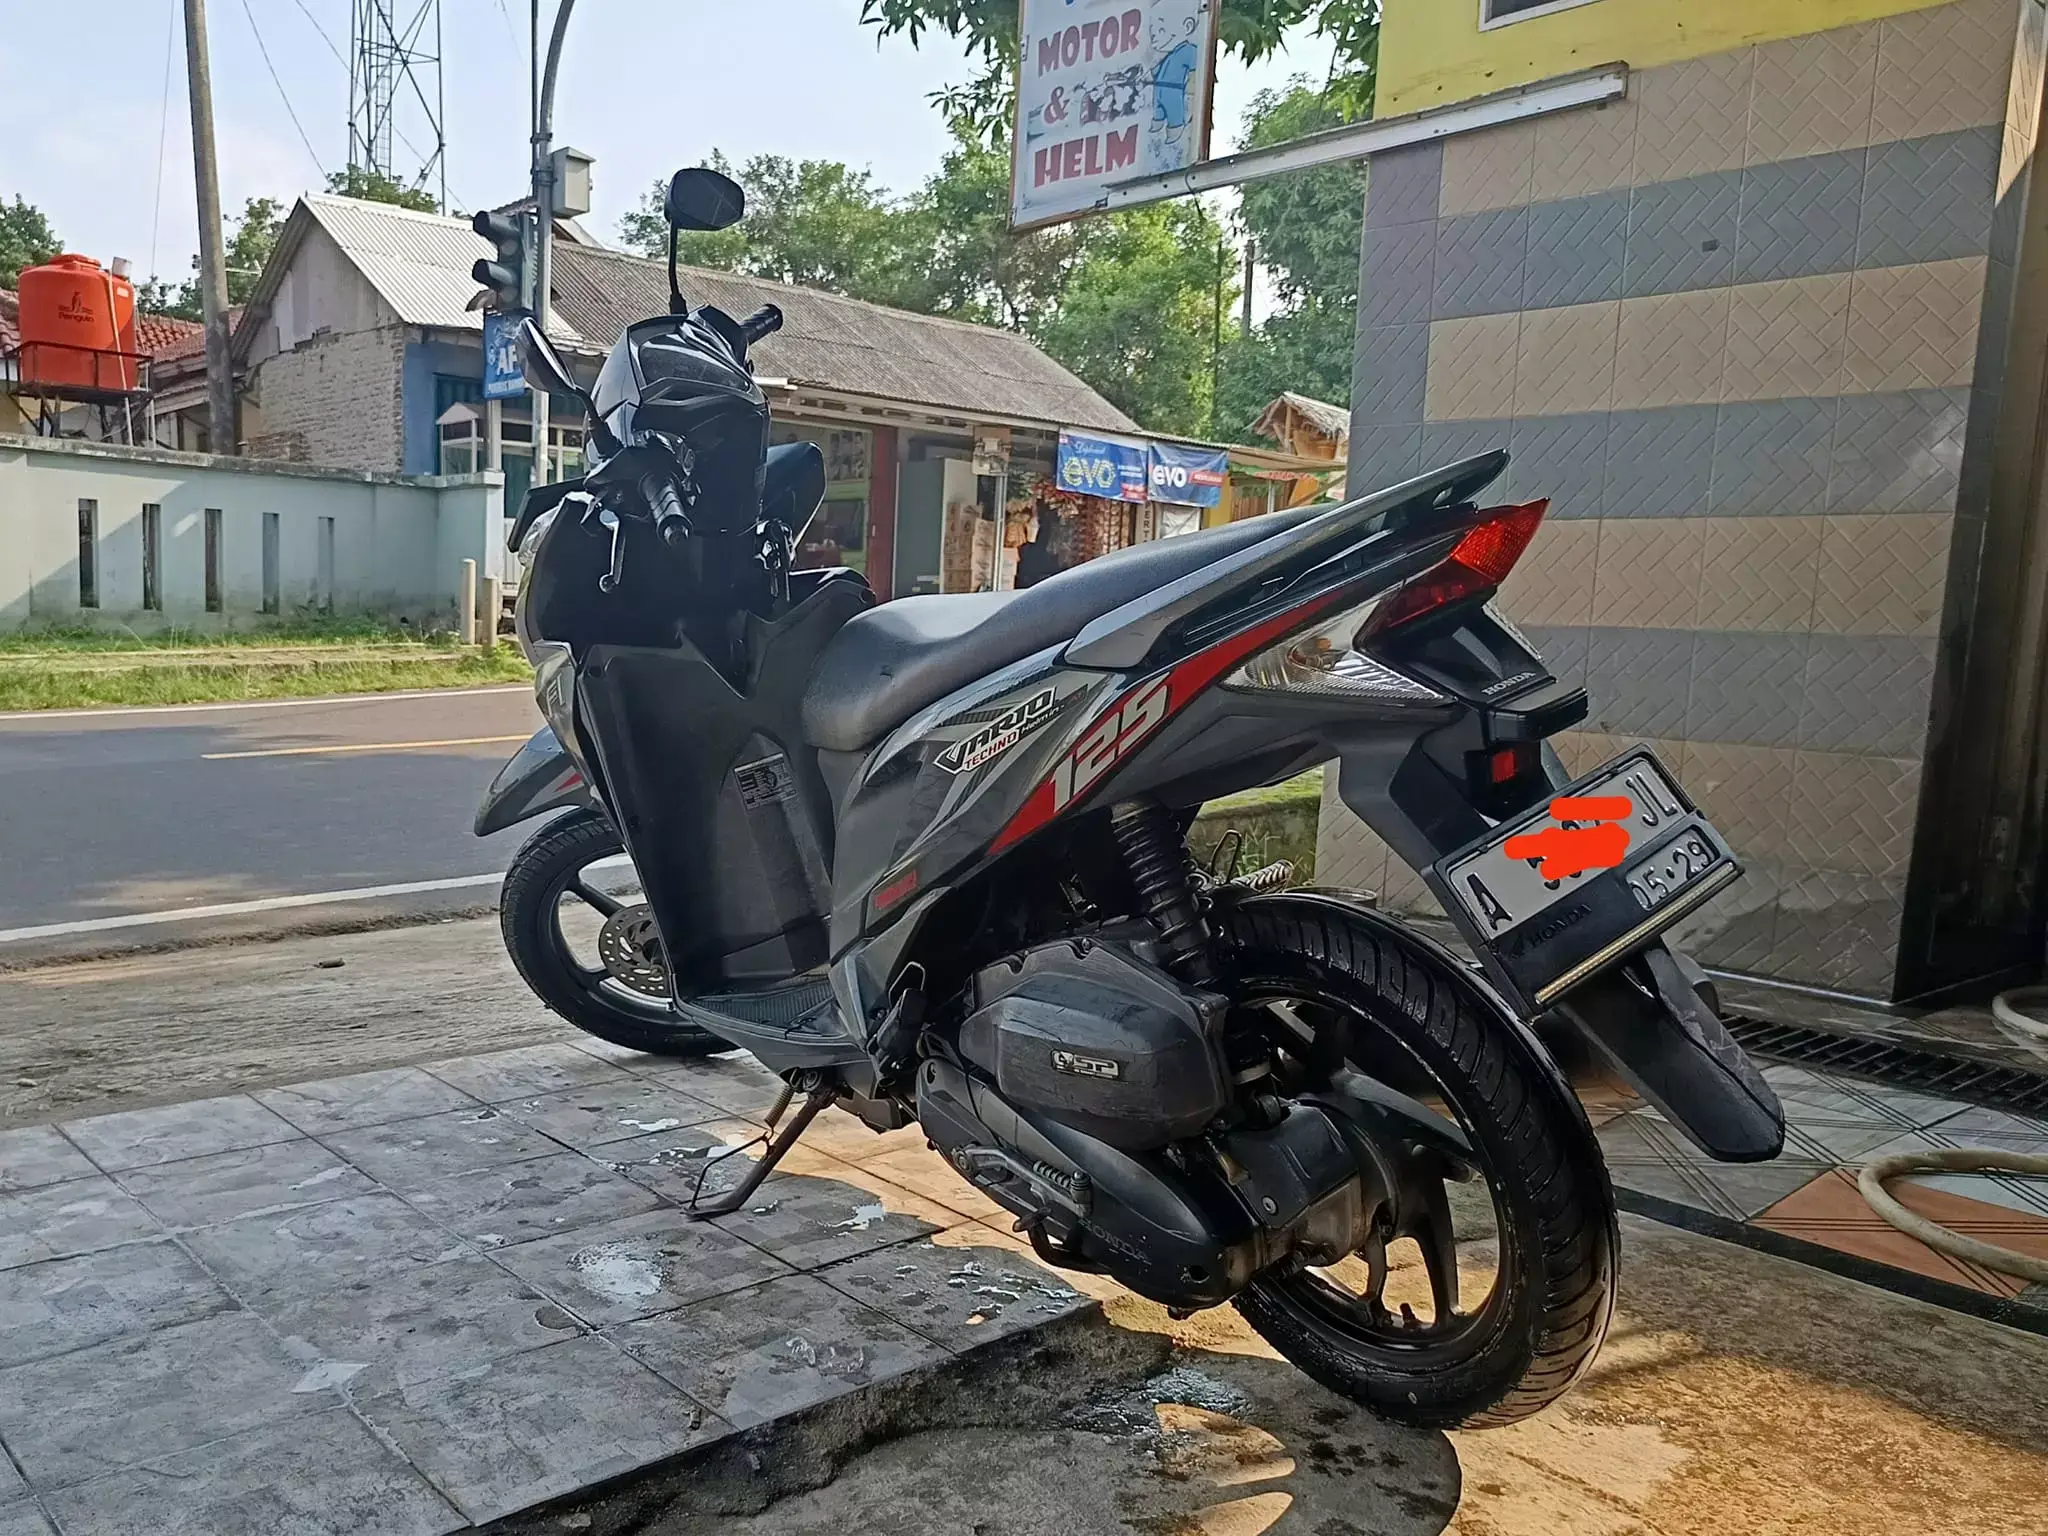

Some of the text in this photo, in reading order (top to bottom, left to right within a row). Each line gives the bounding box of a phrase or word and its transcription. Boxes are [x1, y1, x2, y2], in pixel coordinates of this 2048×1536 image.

[1038, 8, 1142, 78] MOTOR
[1043, 86, 1070, 124] &
[1034, 124, 1139, 188] HELM
[1063, 456, 1116, 489] evo
[1152, 465, 1187, 488] evo
[1143, 501, 1152, 542] PERT
[1481, 672, 1536, 695] HONDA
[934, 687, 1056, 774] VARIO
[964, 732, 1018, 770] TECHNO
[1051, 673, 1169, 813] 125
[1467, 771, 1679, 931] A JL
[1529, 903, 1593, 949] HONDA
